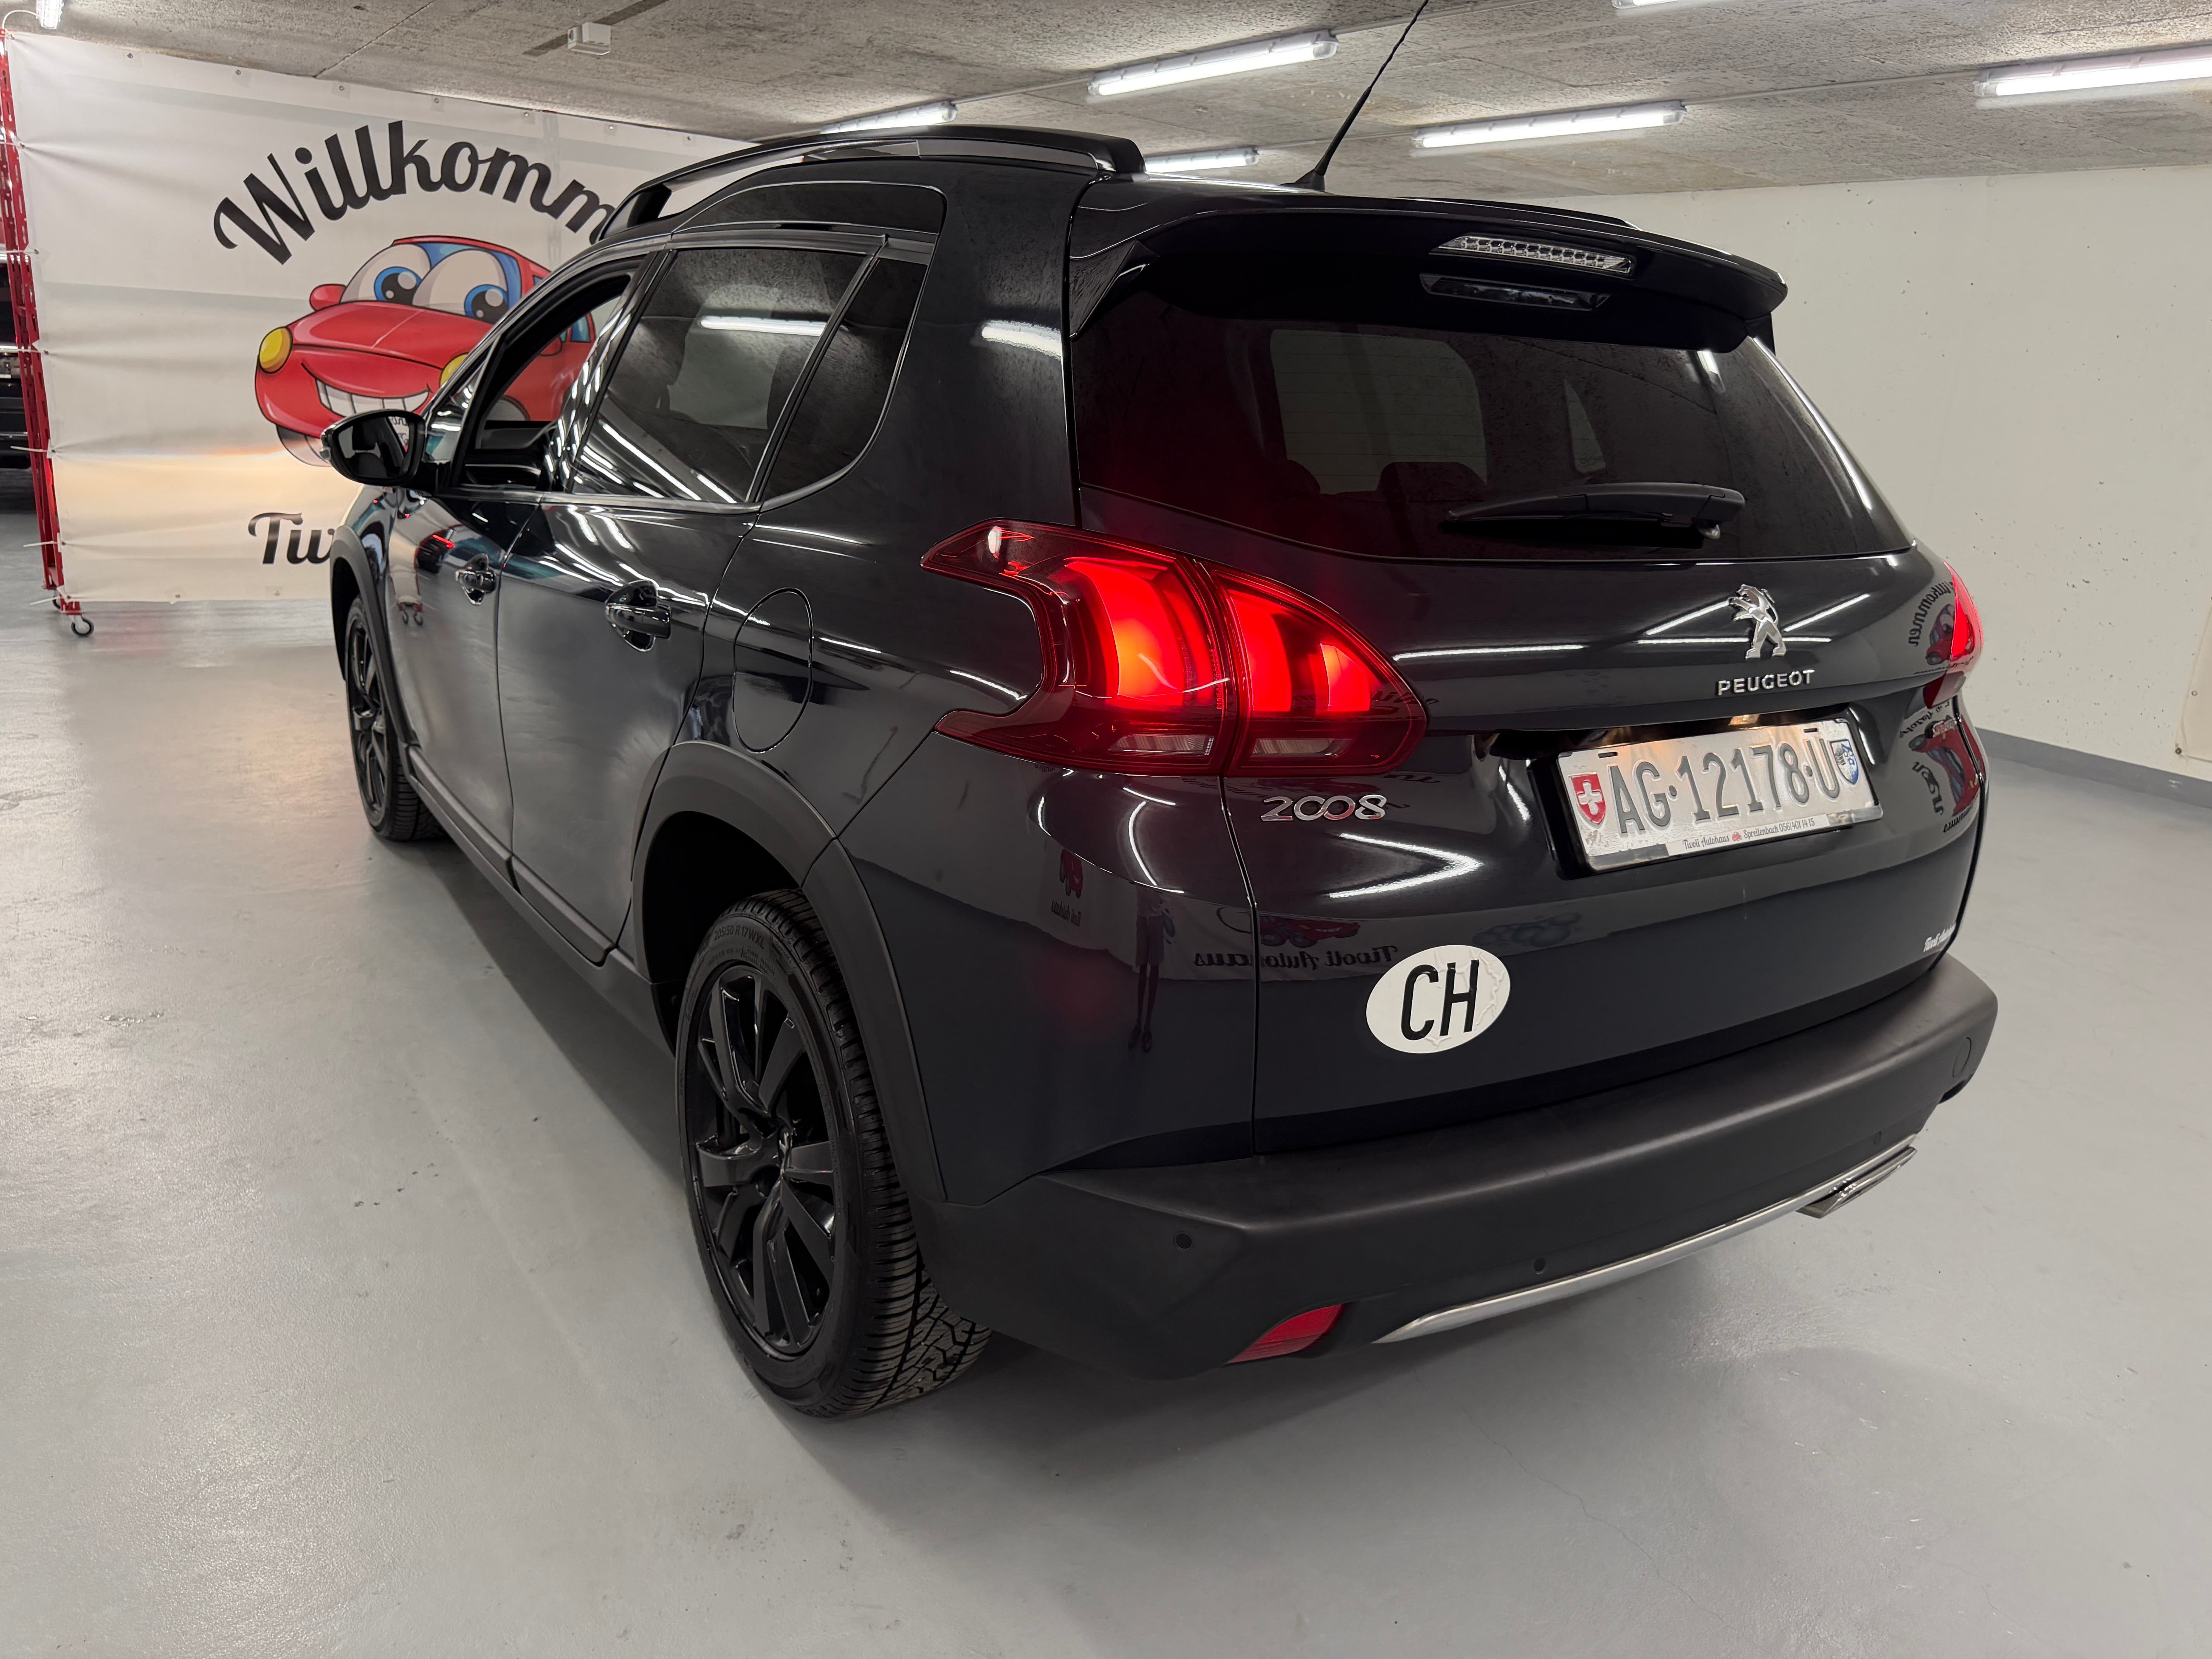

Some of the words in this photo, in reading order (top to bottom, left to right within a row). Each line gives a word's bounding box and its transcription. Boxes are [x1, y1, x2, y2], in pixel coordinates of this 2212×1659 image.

[1717, 670, 1815, 696] PEUGEOT
[1261, 794, 1387, 822] 2008
[1682, 839, 1700, 849] Tivoli
[1701, 835, 1729, 846] Autohaus
[714, 924, 734, 941] 205/50
[735, 924, 740, 936] R
[1401, 958, 1480, 1041] CH
